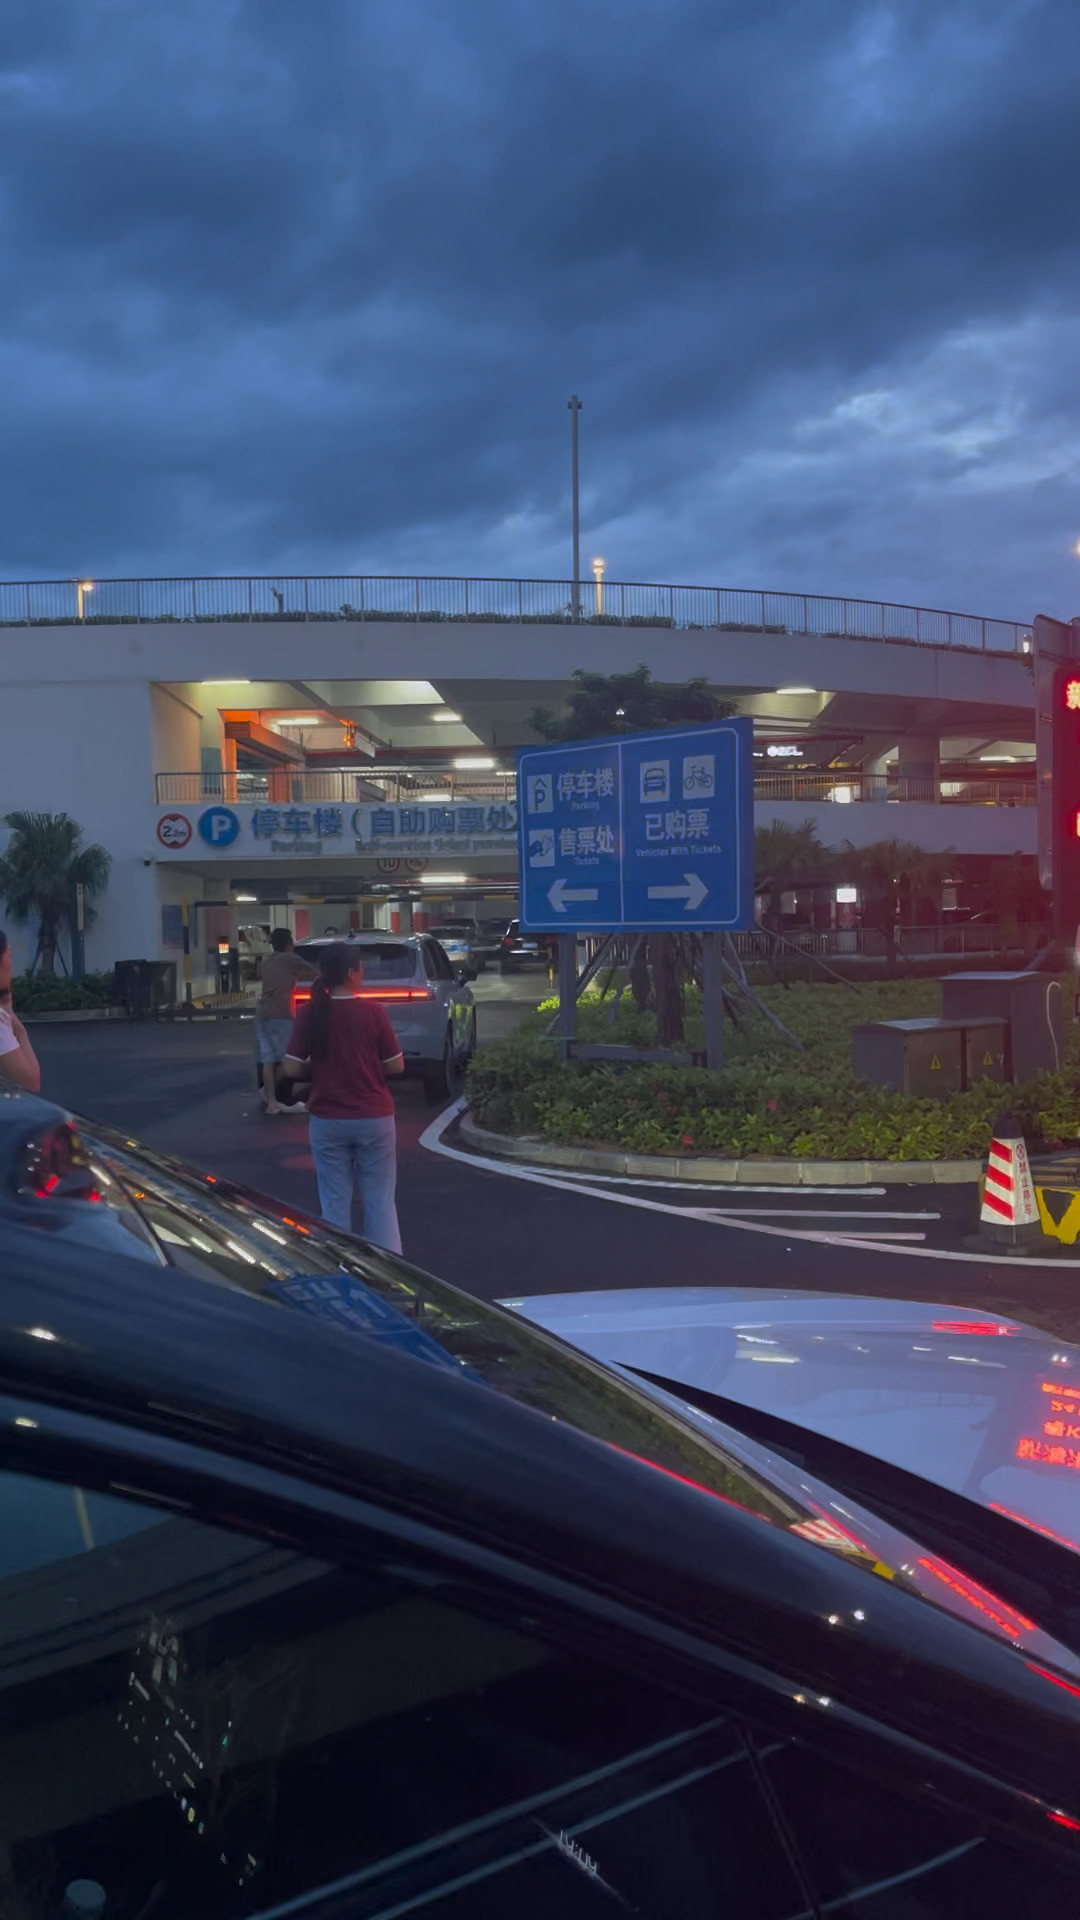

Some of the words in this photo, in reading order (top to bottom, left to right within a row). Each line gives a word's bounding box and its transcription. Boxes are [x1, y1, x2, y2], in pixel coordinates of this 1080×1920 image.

[557, 768, 615, 801] 停车楼
[211, 815, 232, 840] P
[560, 824, 615, 856] 售票处
[644, 808, 710, 841] 已购票
